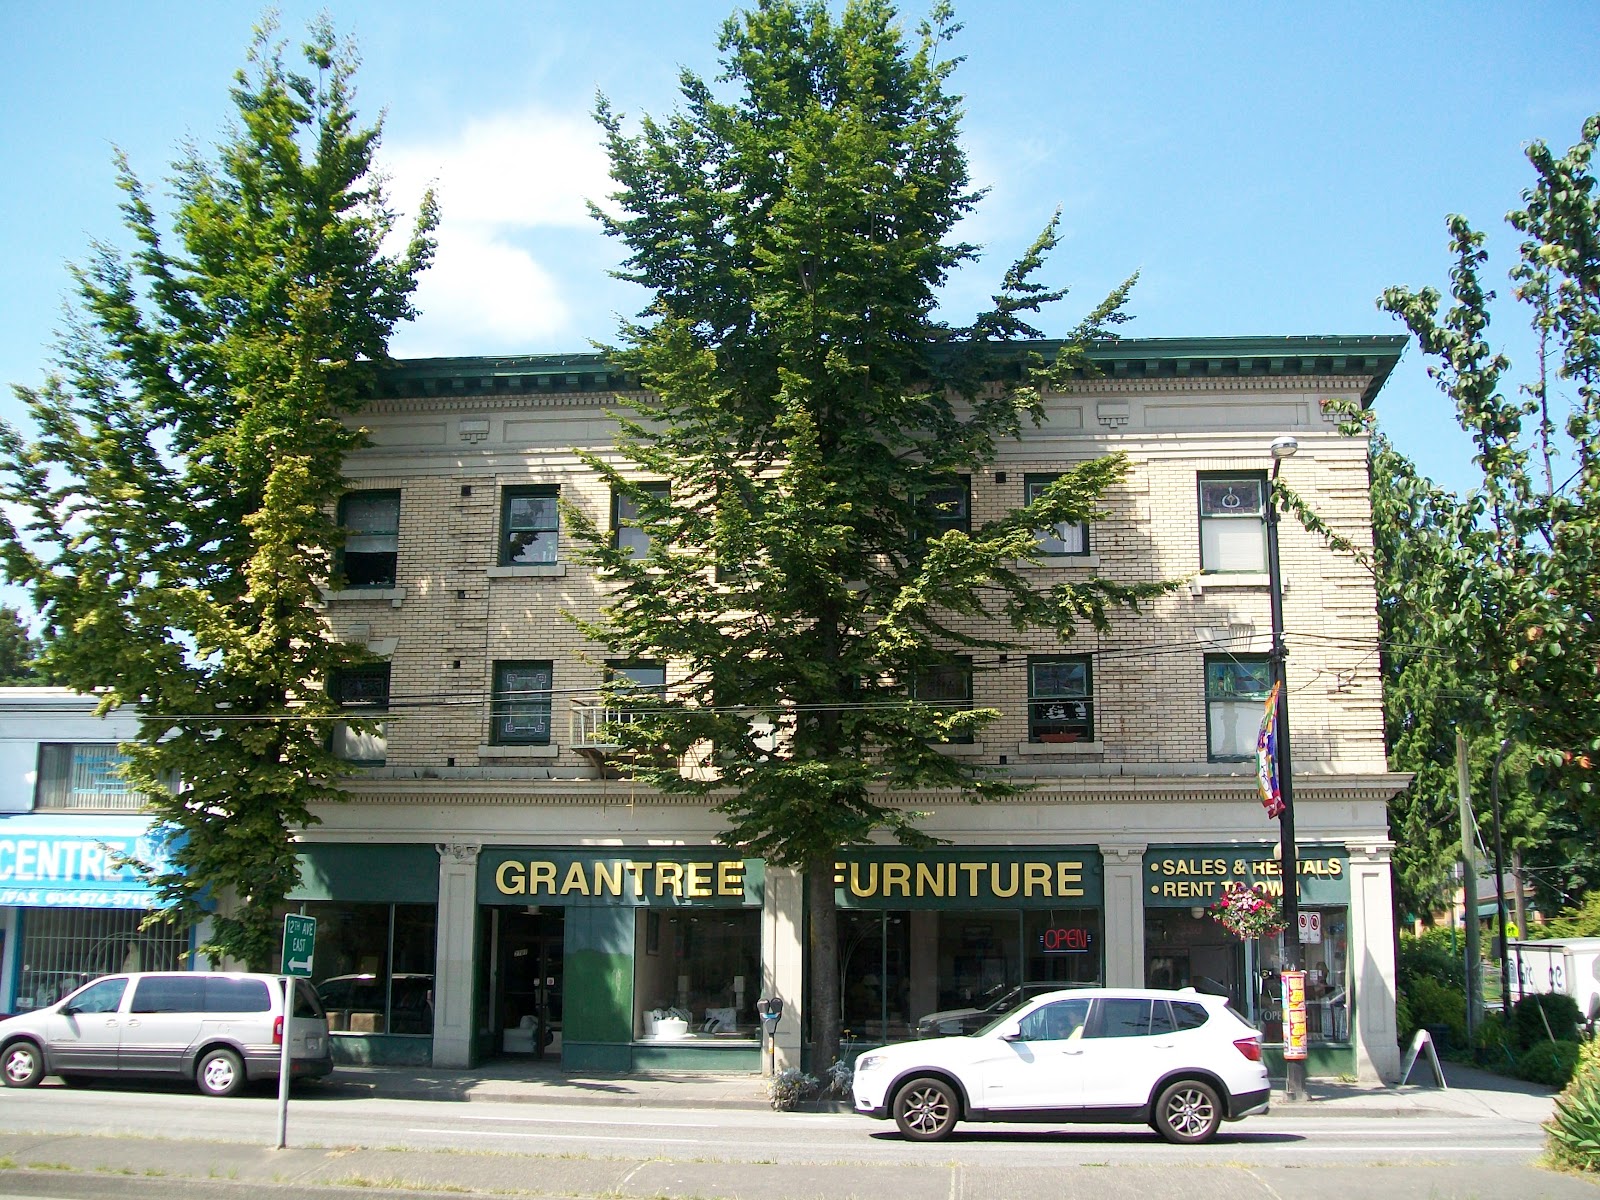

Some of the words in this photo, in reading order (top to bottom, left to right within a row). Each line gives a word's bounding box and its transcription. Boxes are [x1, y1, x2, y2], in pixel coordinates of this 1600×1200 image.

[0, 840, 126, 882] CENTRE
[1162, 859, 1227, 875] SALES
[1233, 859, 1246, 875] &
[1252, 858, 1342, 875] RETALS
[495, 860, 746, 897] GRANTREE
[1163, 881, 1216, 897] RENT
[1253, 881, 1300, 897] OW
[287, 919, 301, 934] 12TH
[301, 922, 314, 936] AVE
[292, 938, 306, 952] EAST
[1044, 928, 1089, 949] OPEN
